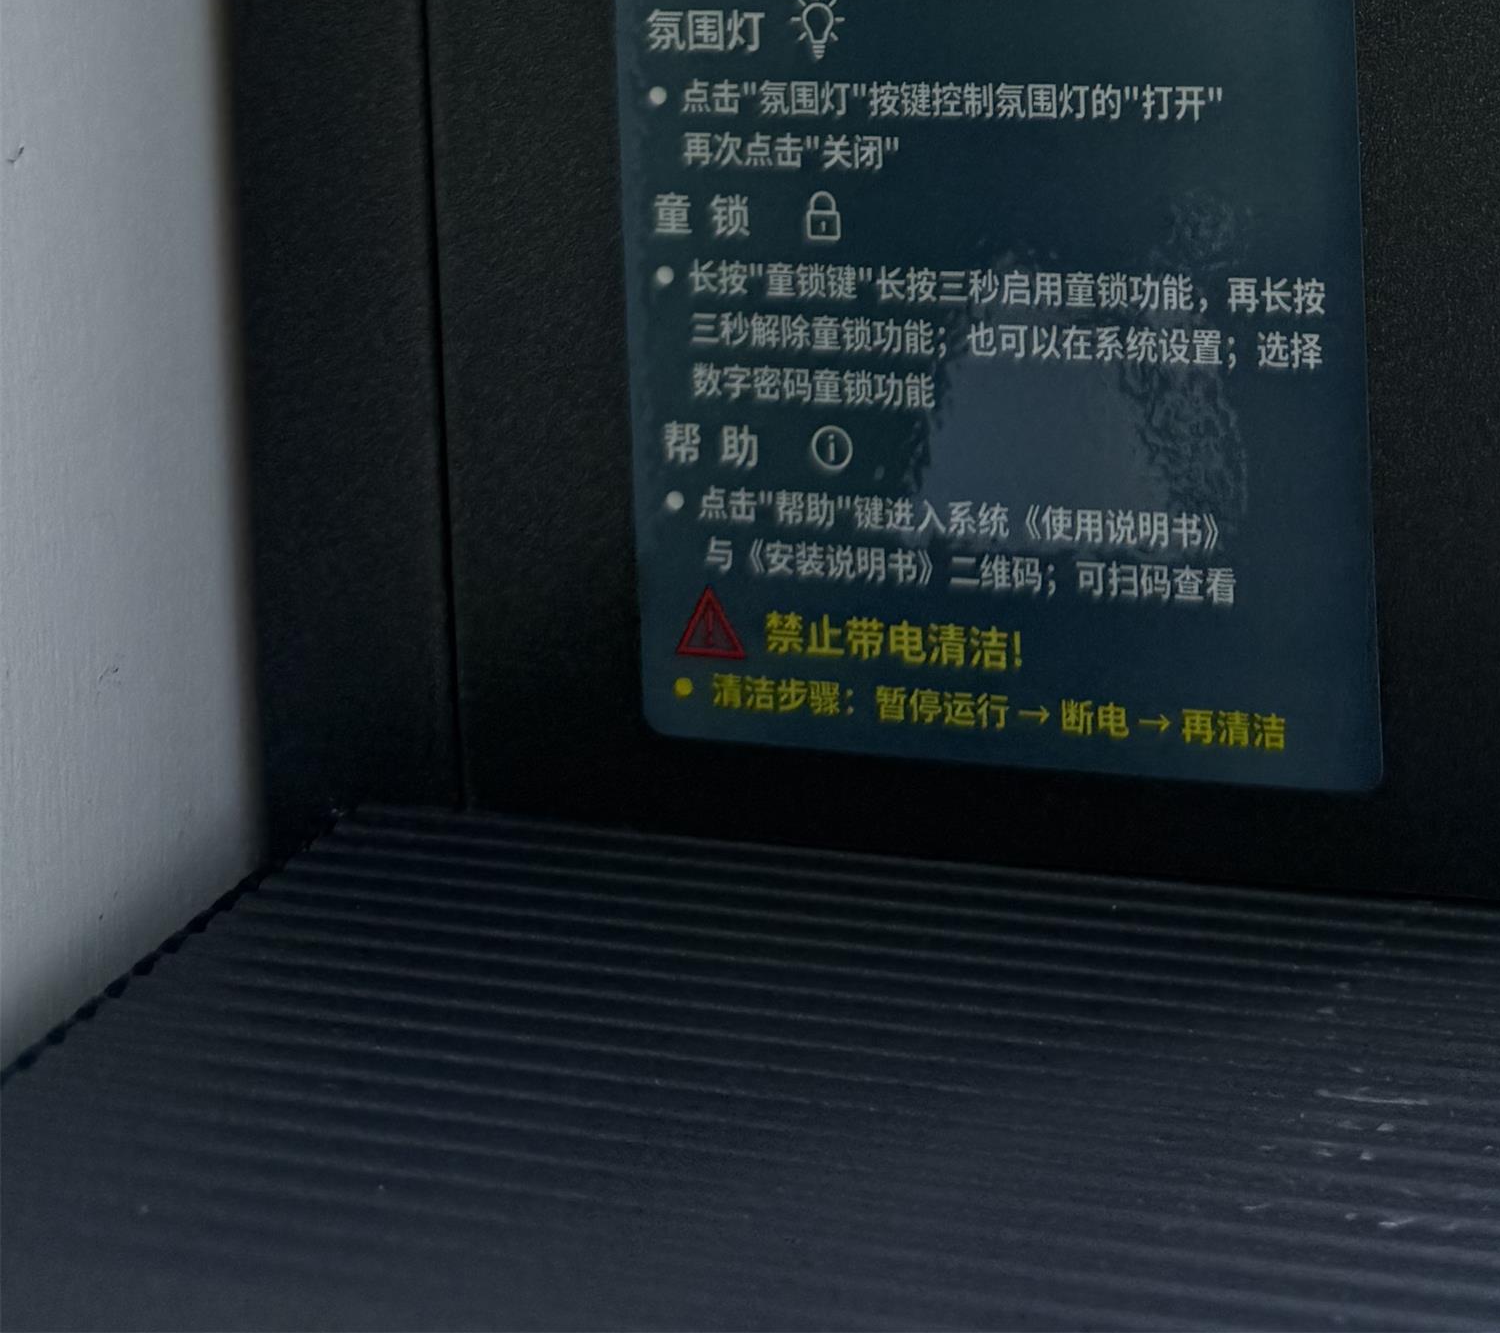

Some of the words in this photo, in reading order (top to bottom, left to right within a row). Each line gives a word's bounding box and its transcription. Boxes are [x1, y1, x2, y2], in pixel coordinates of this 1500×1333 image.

[646, 10, 766, 54] 氛围灯
[691, 365, 936, 409] 数字密码童锁功能
